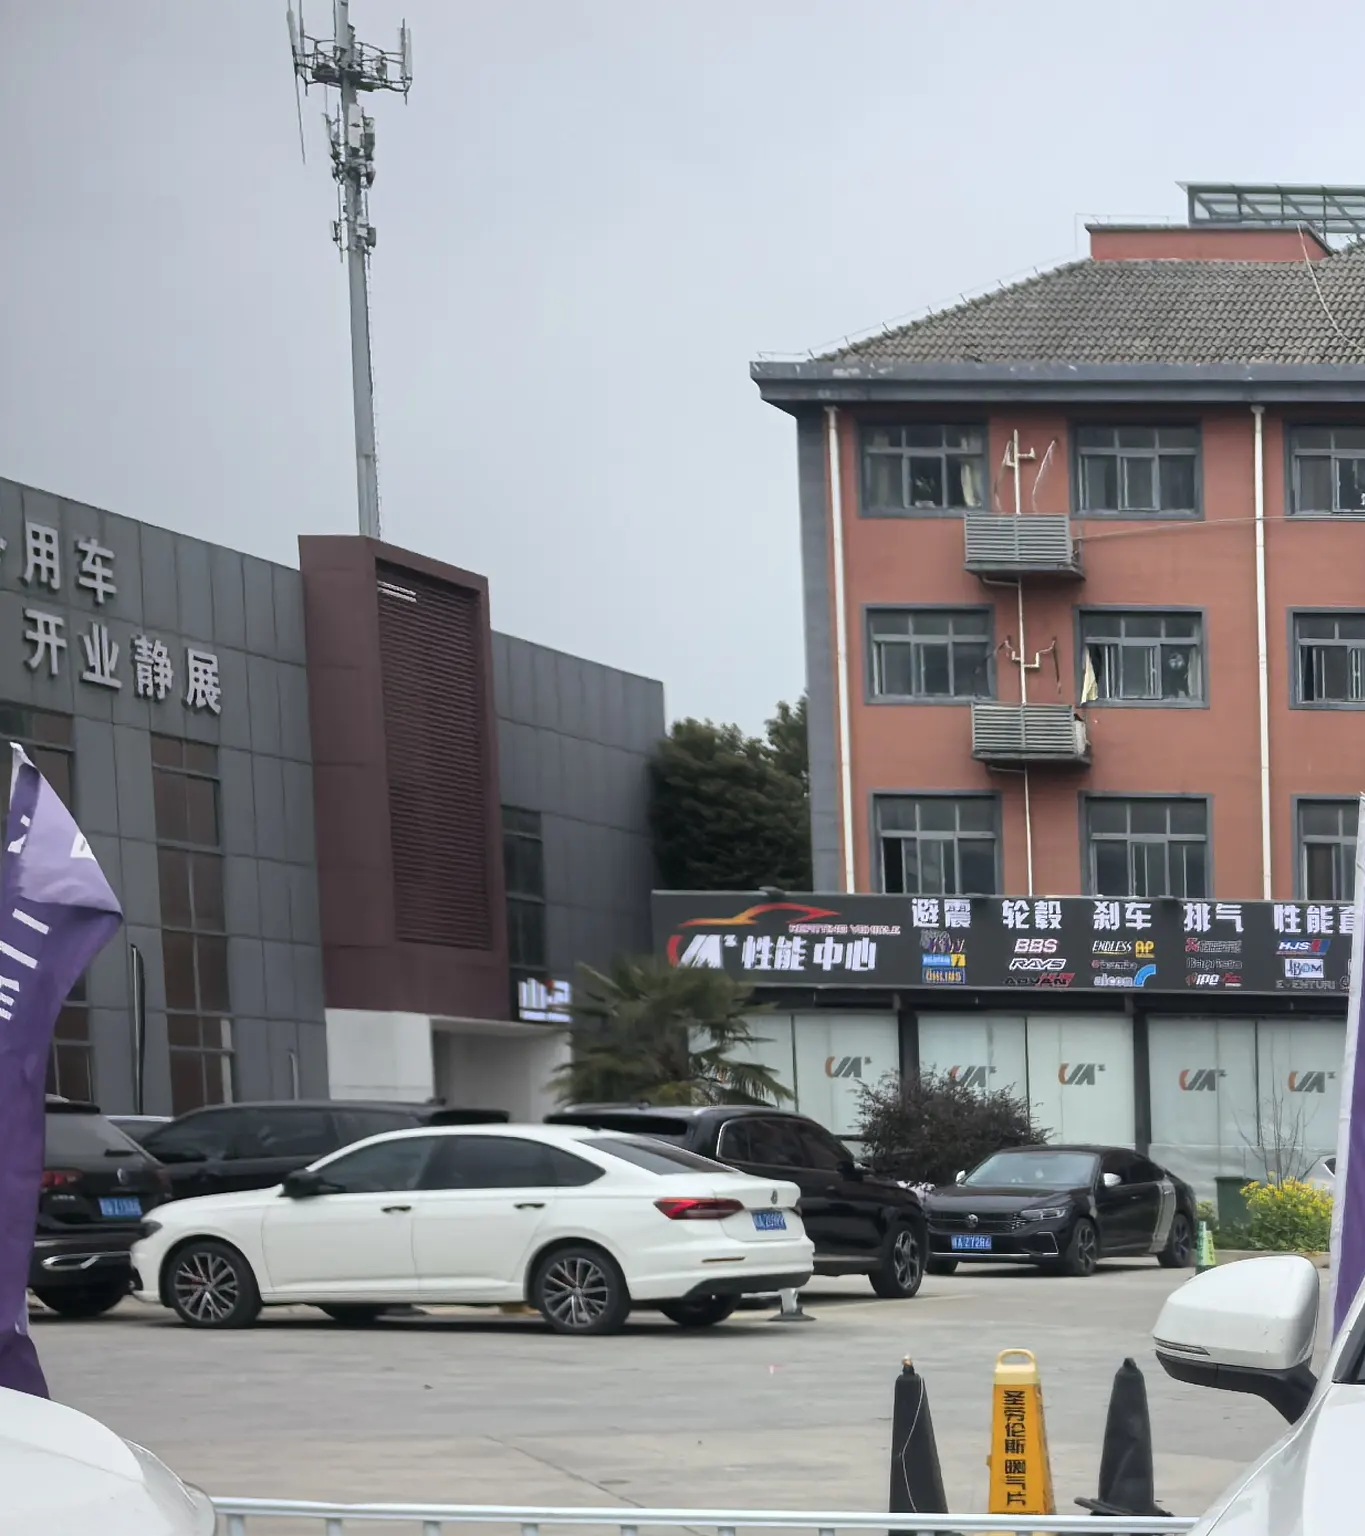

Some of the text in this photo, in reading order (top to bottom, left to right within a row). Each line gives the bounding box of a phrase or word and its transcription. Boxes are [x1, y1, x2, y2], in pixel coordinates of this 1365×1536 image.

[0, 520, 117, 603] 用车
[25, 608, 222, 714] 开业静展
[911, 898, 971, 928] 避震
[1002, 900, 1062, 929] 轮毂
[1093, 900, 1152, 931] 刹车
[1183, 902, 1244, 932] 排气
[741, 934, 877, 972] 性能中心
[1014, 938, 1058, 953] BBS
[1092, 940, 1132, 953] ENDLESS
[1279, 941, 1311, 950] HJS
